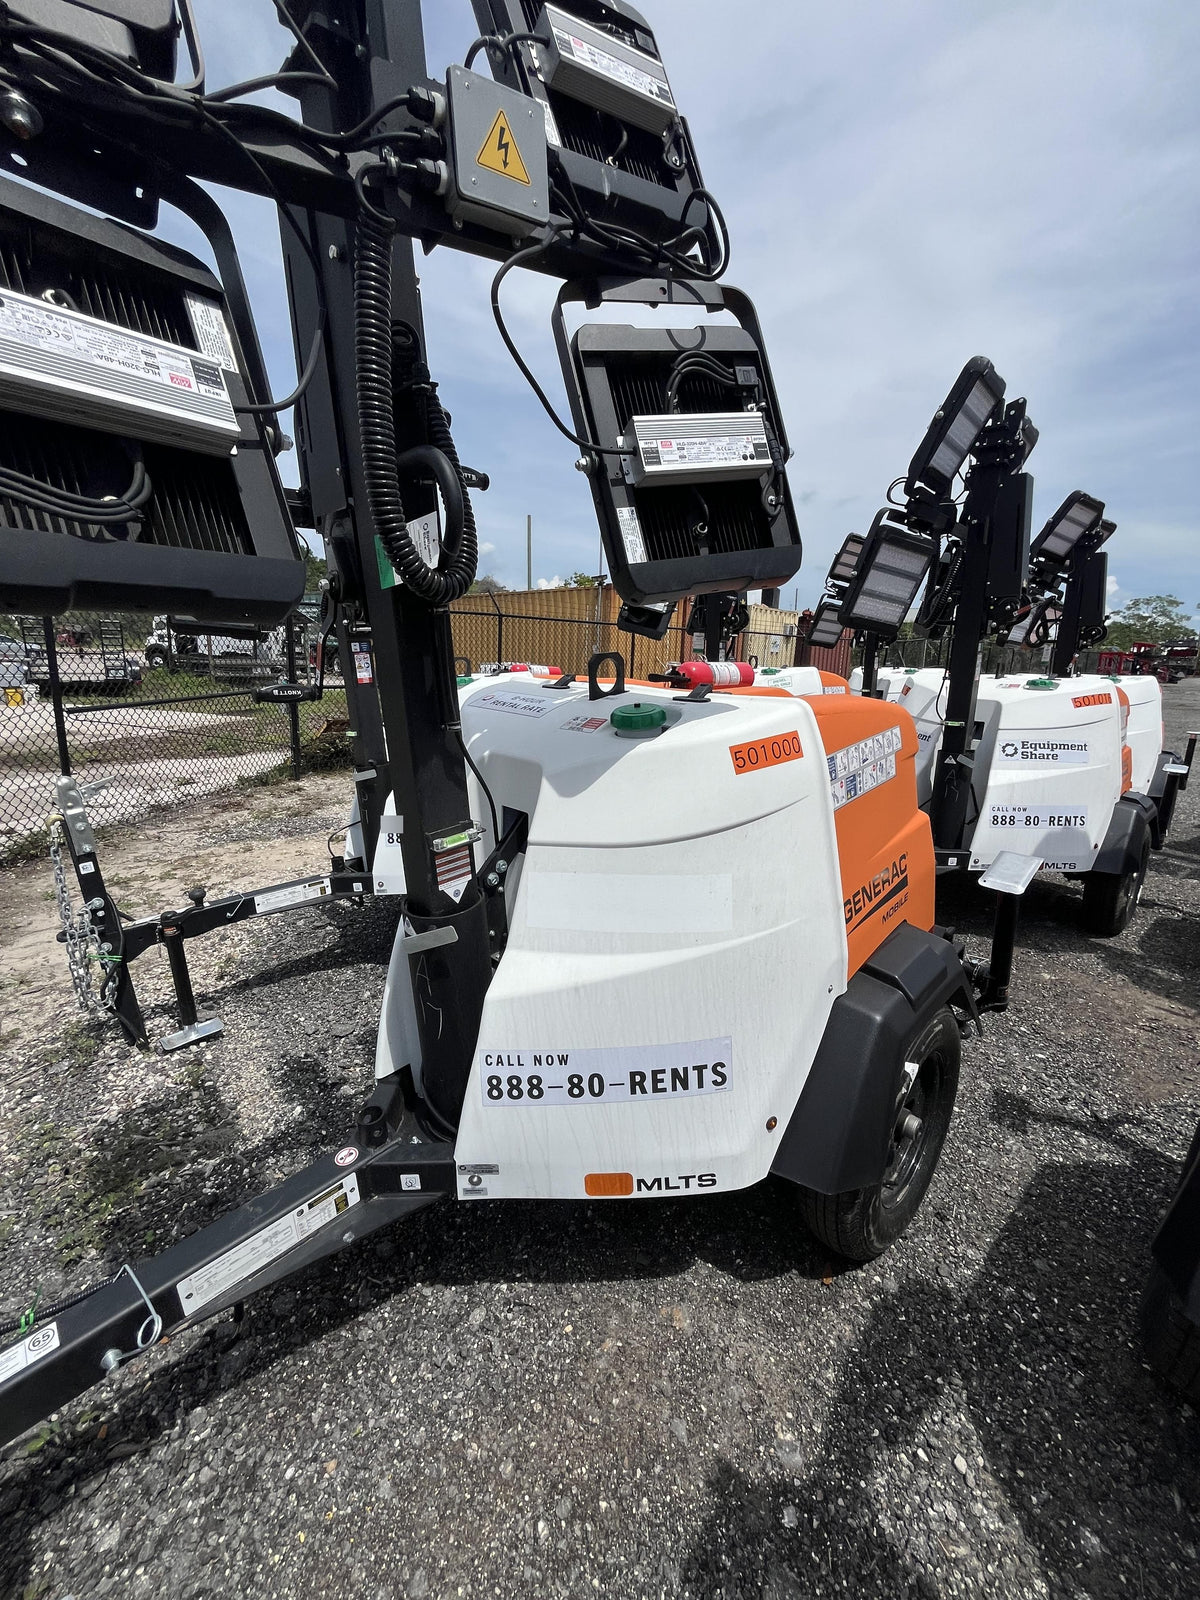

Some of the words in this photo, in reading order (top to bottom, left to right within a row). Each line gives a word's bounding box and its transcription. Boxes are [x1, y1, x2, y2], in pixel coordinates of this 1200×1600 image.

[489, 700, 521, 710] RENTAL
[520, 704, 547, 713] RATE
[734, 736, 801, 768] 501000
[1021, 741, 1088, 752] Equipment
[1021, 751, 1059, 761] Share
[1044, 862, 1077, 870] MLTS
[844, 853, 908, 925] GENERAC
[881, 892, 909, 925] MOBILE
[485, 1054, 525, 1067] CALL
[533, 1054, 569, 1067] NOW
[486, 1061, 728, 1101] 888-80-RENTS
[636, 1173, 718, 1192] MLTS
[32, 1330, 51, 1348] 65
